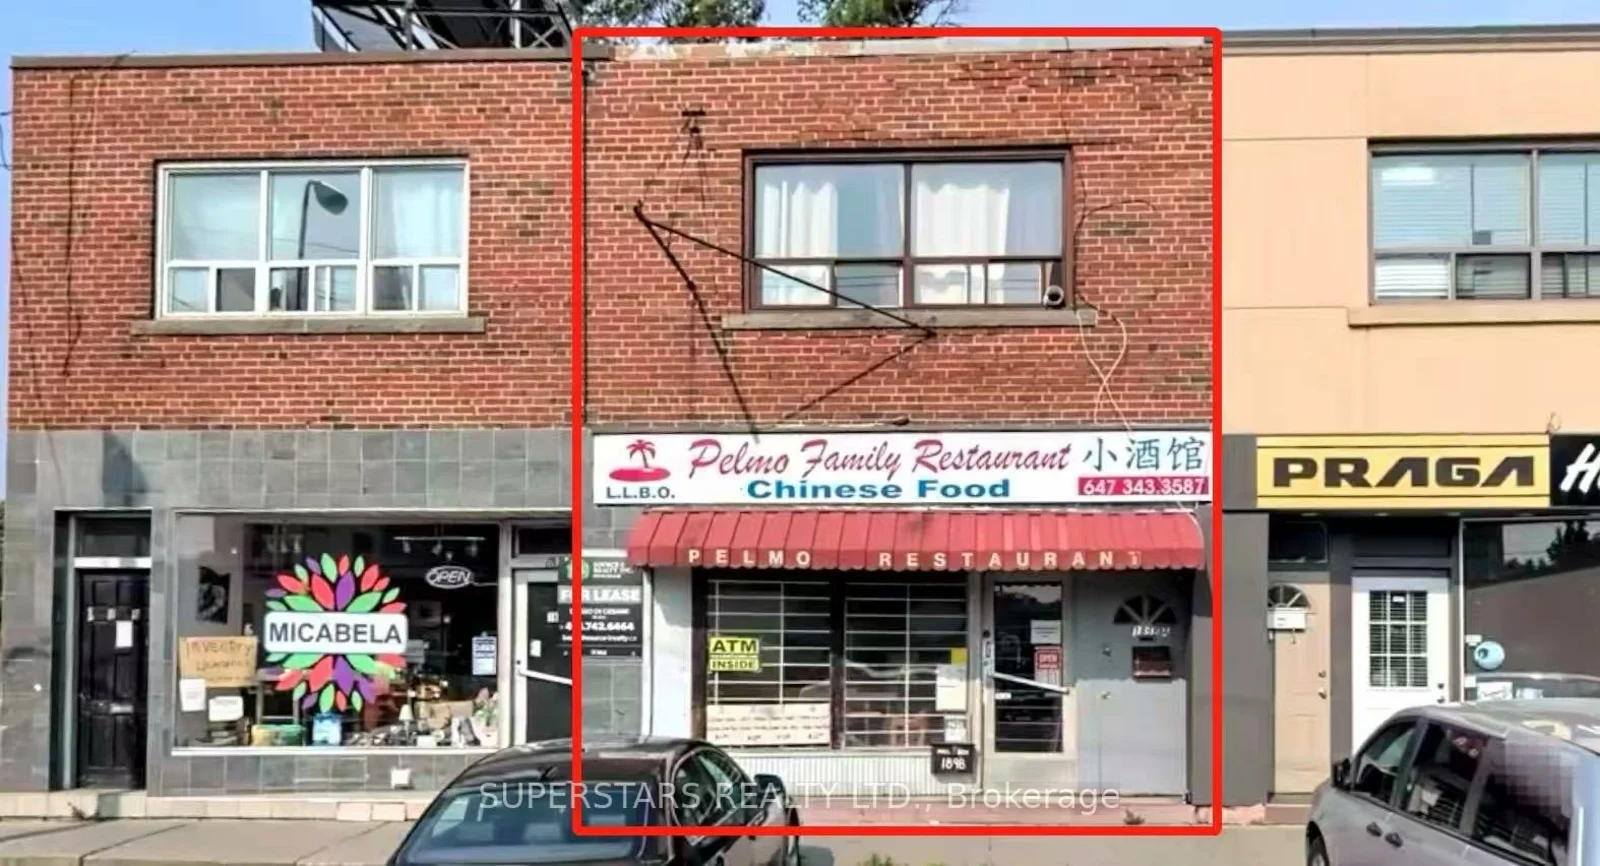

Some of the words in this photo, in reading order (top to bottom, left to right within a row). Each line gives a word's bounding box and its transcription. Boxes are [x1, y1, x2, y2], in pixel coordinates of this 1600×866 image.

[689, 438, 790, 479] Pelmo
[800, 438, 902, 481] Family
[912, 438, 1072, 474] Restaurant
[1083, 436, 1206, 472] 小酒馆
[1273, 455, 1535, 488] PRAGA
[1559, 443, 1600, 494] H
[605, 486, 676, 500] L.L.B.O.
[747, 479, 902, 499] Chinese
[917, 478, 1010, 499] Food
[1083, 480, 1114, 495] 647
[1121, 478, 1205, 495] 343.3587
[688, 549, 810, 565] PELMO
[878, 551, 1143, 569] RESTAURANT
[427, 569, 471, 584] OPEN
[561, 588, 590, 601] FR
[593, 588, 641, 601] LEASE
[269, 622, 402, 643] MICABELA
[712, 640, 757, 652] ATM
[712, 660, 755, 669] INSIDE
